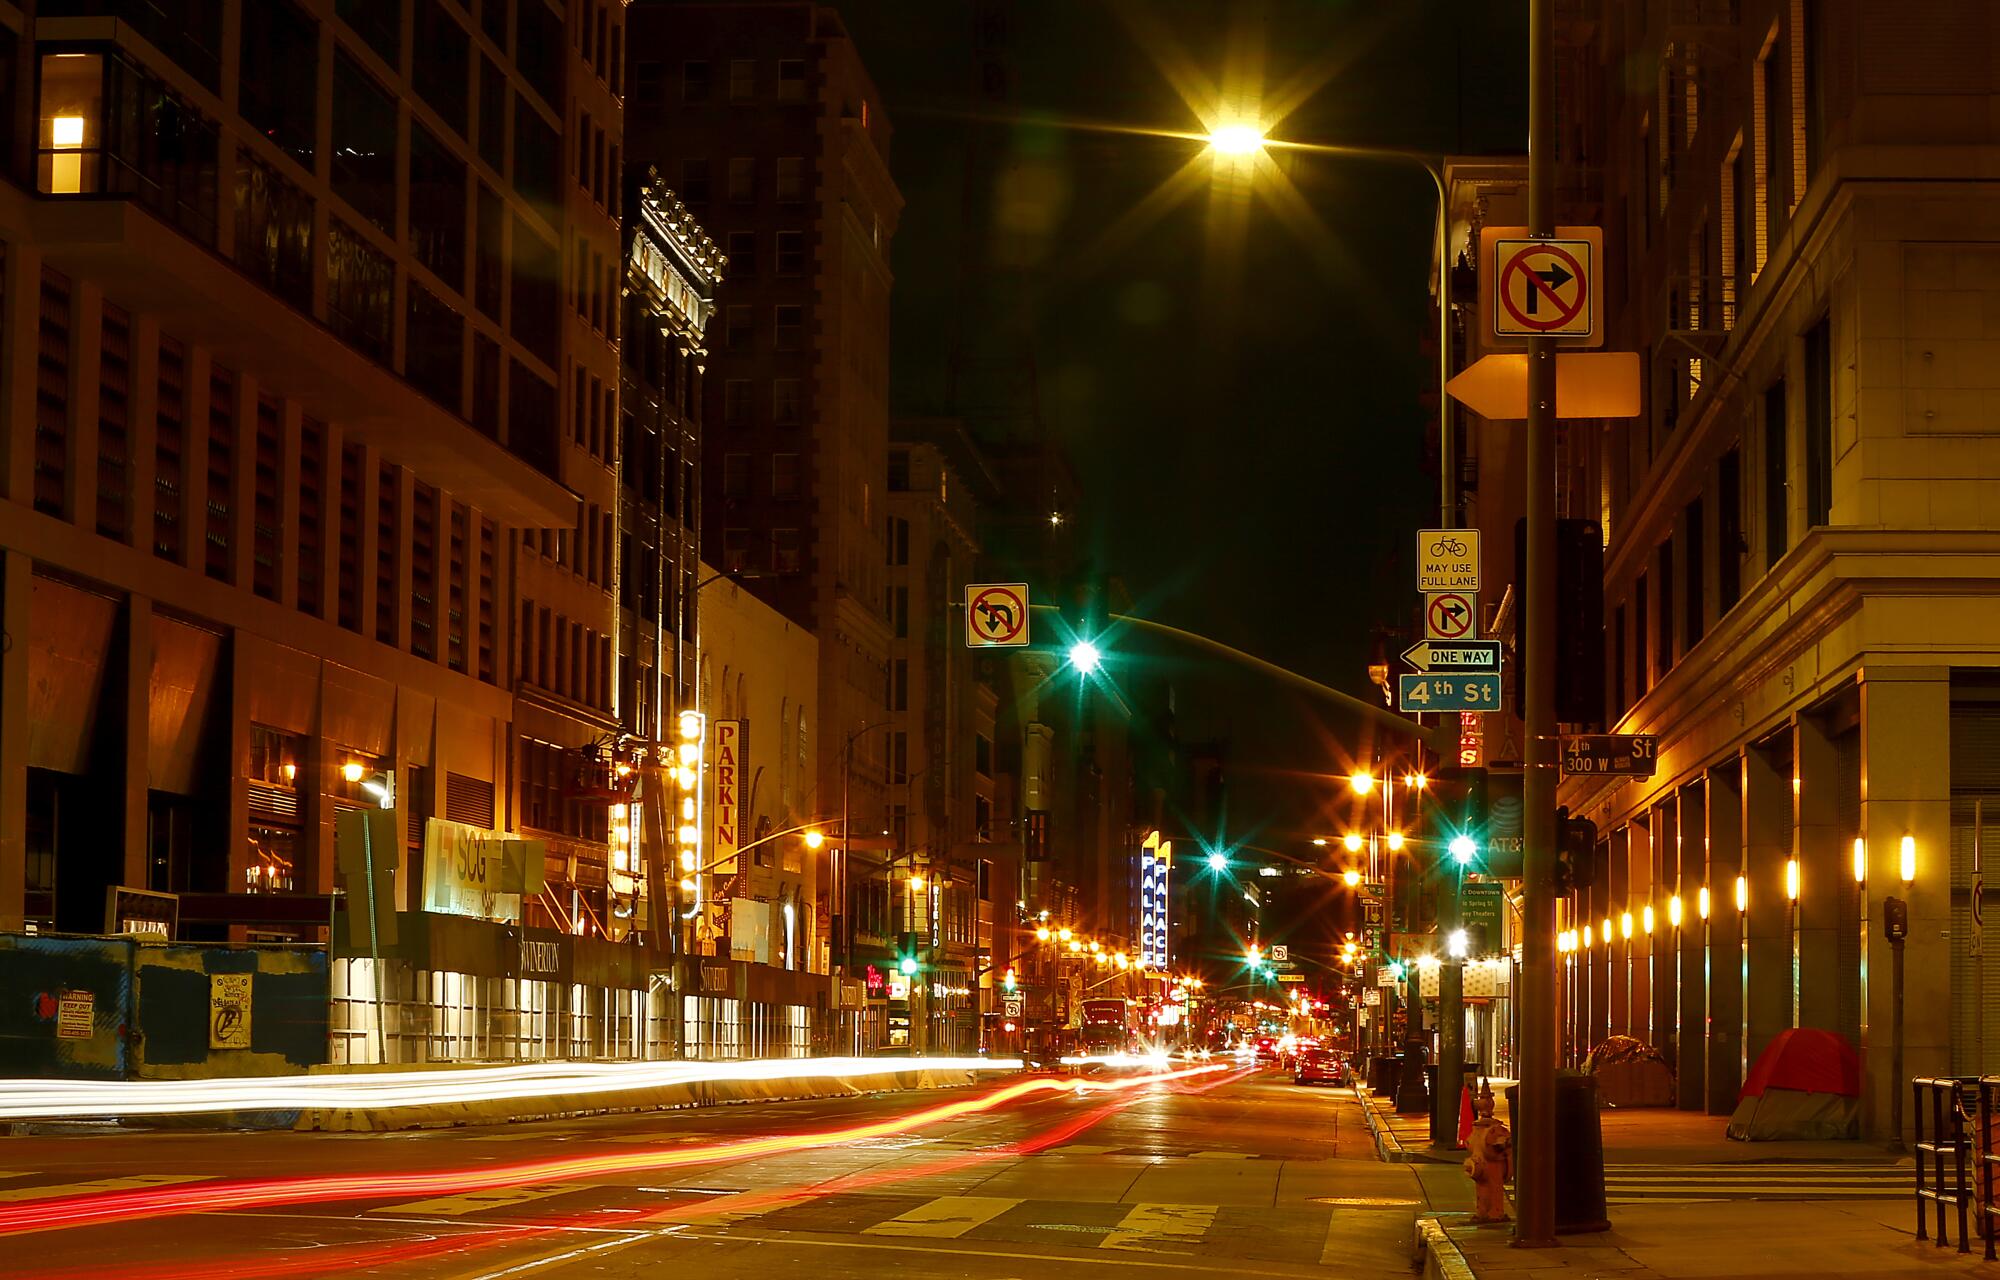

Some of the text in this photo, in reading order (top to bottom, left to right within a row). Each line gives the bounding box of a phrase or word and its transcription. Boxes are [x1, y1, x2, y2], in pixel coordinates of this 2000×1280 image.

[1426, 564, 1472, 573] MAY USE
[1421, 577, 1477, 586] FULL LANE
[1431, 651, 1490, 663] ONE WAY
[1408, 680, 1492, 704] 4th St
[1567, 738, 1652, 758] 4th St
[1567, 757, 1592, 771] 300
[1598, 758, 1608, 771] W
[718, 726, 735, 864] PARKIN
[1488, 837, 1523, 853] AT&
[1143, 856, 1154, 965] PALACE
[1155, 864, 1166, 967] PALACE
[62, 992, 93, 1002] WARNING
